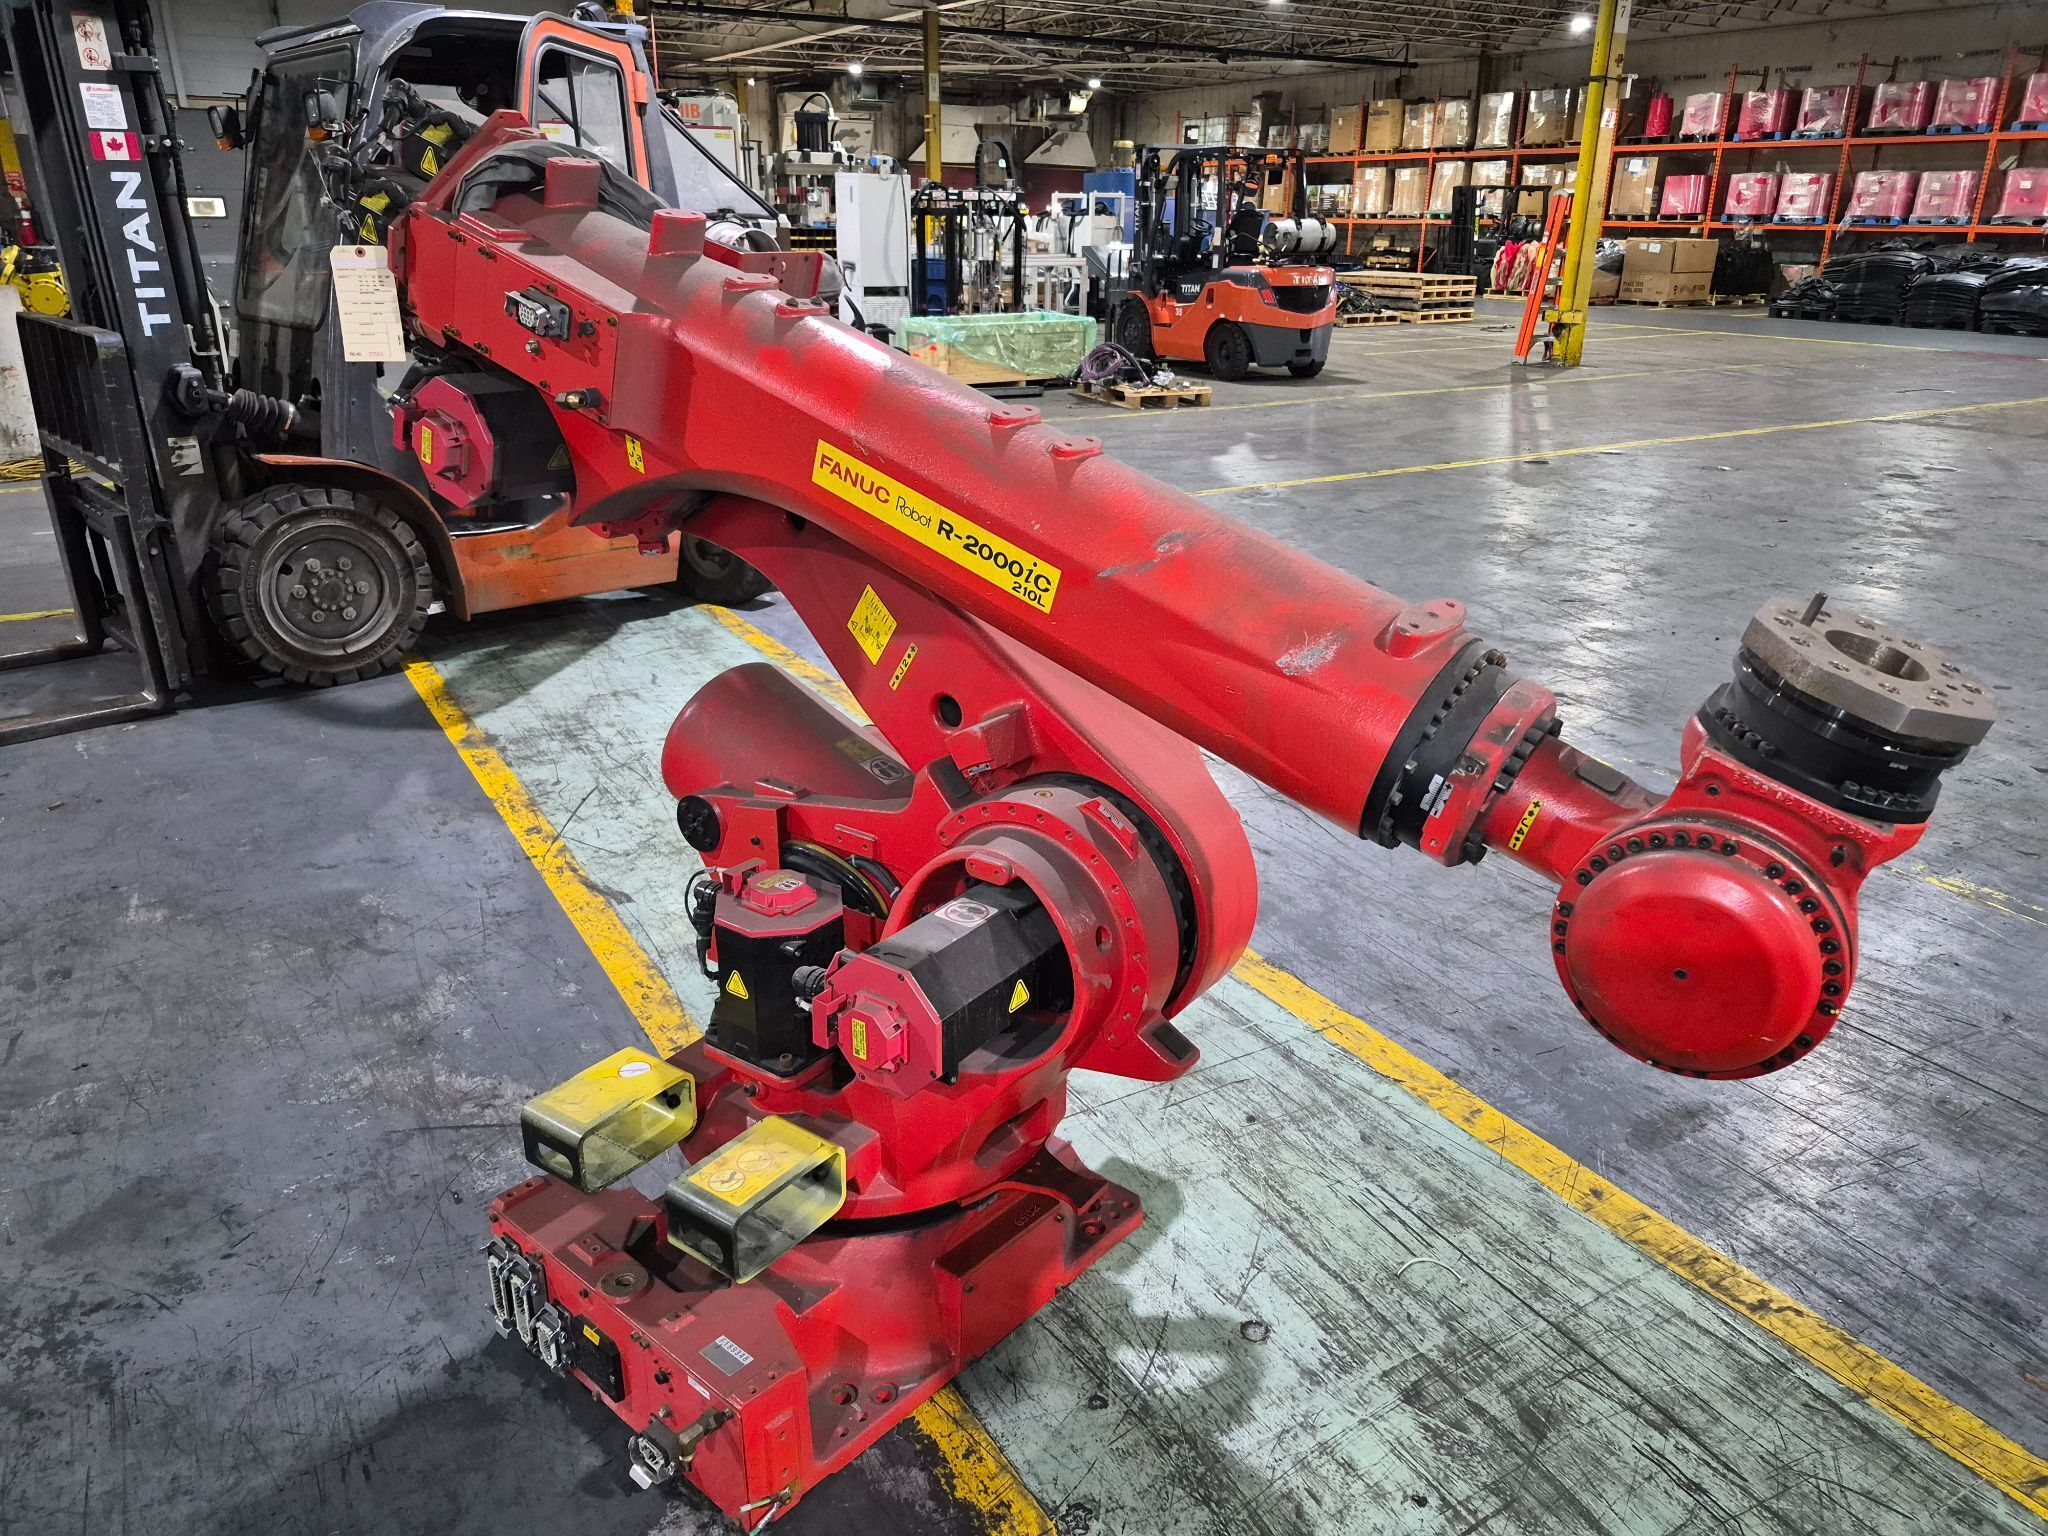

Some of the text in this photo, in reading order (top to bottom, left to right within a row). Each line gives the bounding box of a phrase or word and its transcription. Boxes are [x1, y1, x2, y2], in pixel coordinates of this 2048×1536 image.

[110, 171, 171, 337] TITAN
[1180, 284, 1200, 293] TITAN
[1292, 274, 1327, 285] TITAN
[819, 453, 1052, 593] FANUC Robot R-2000iC
[1011, 581, 1046, 608] 210L
